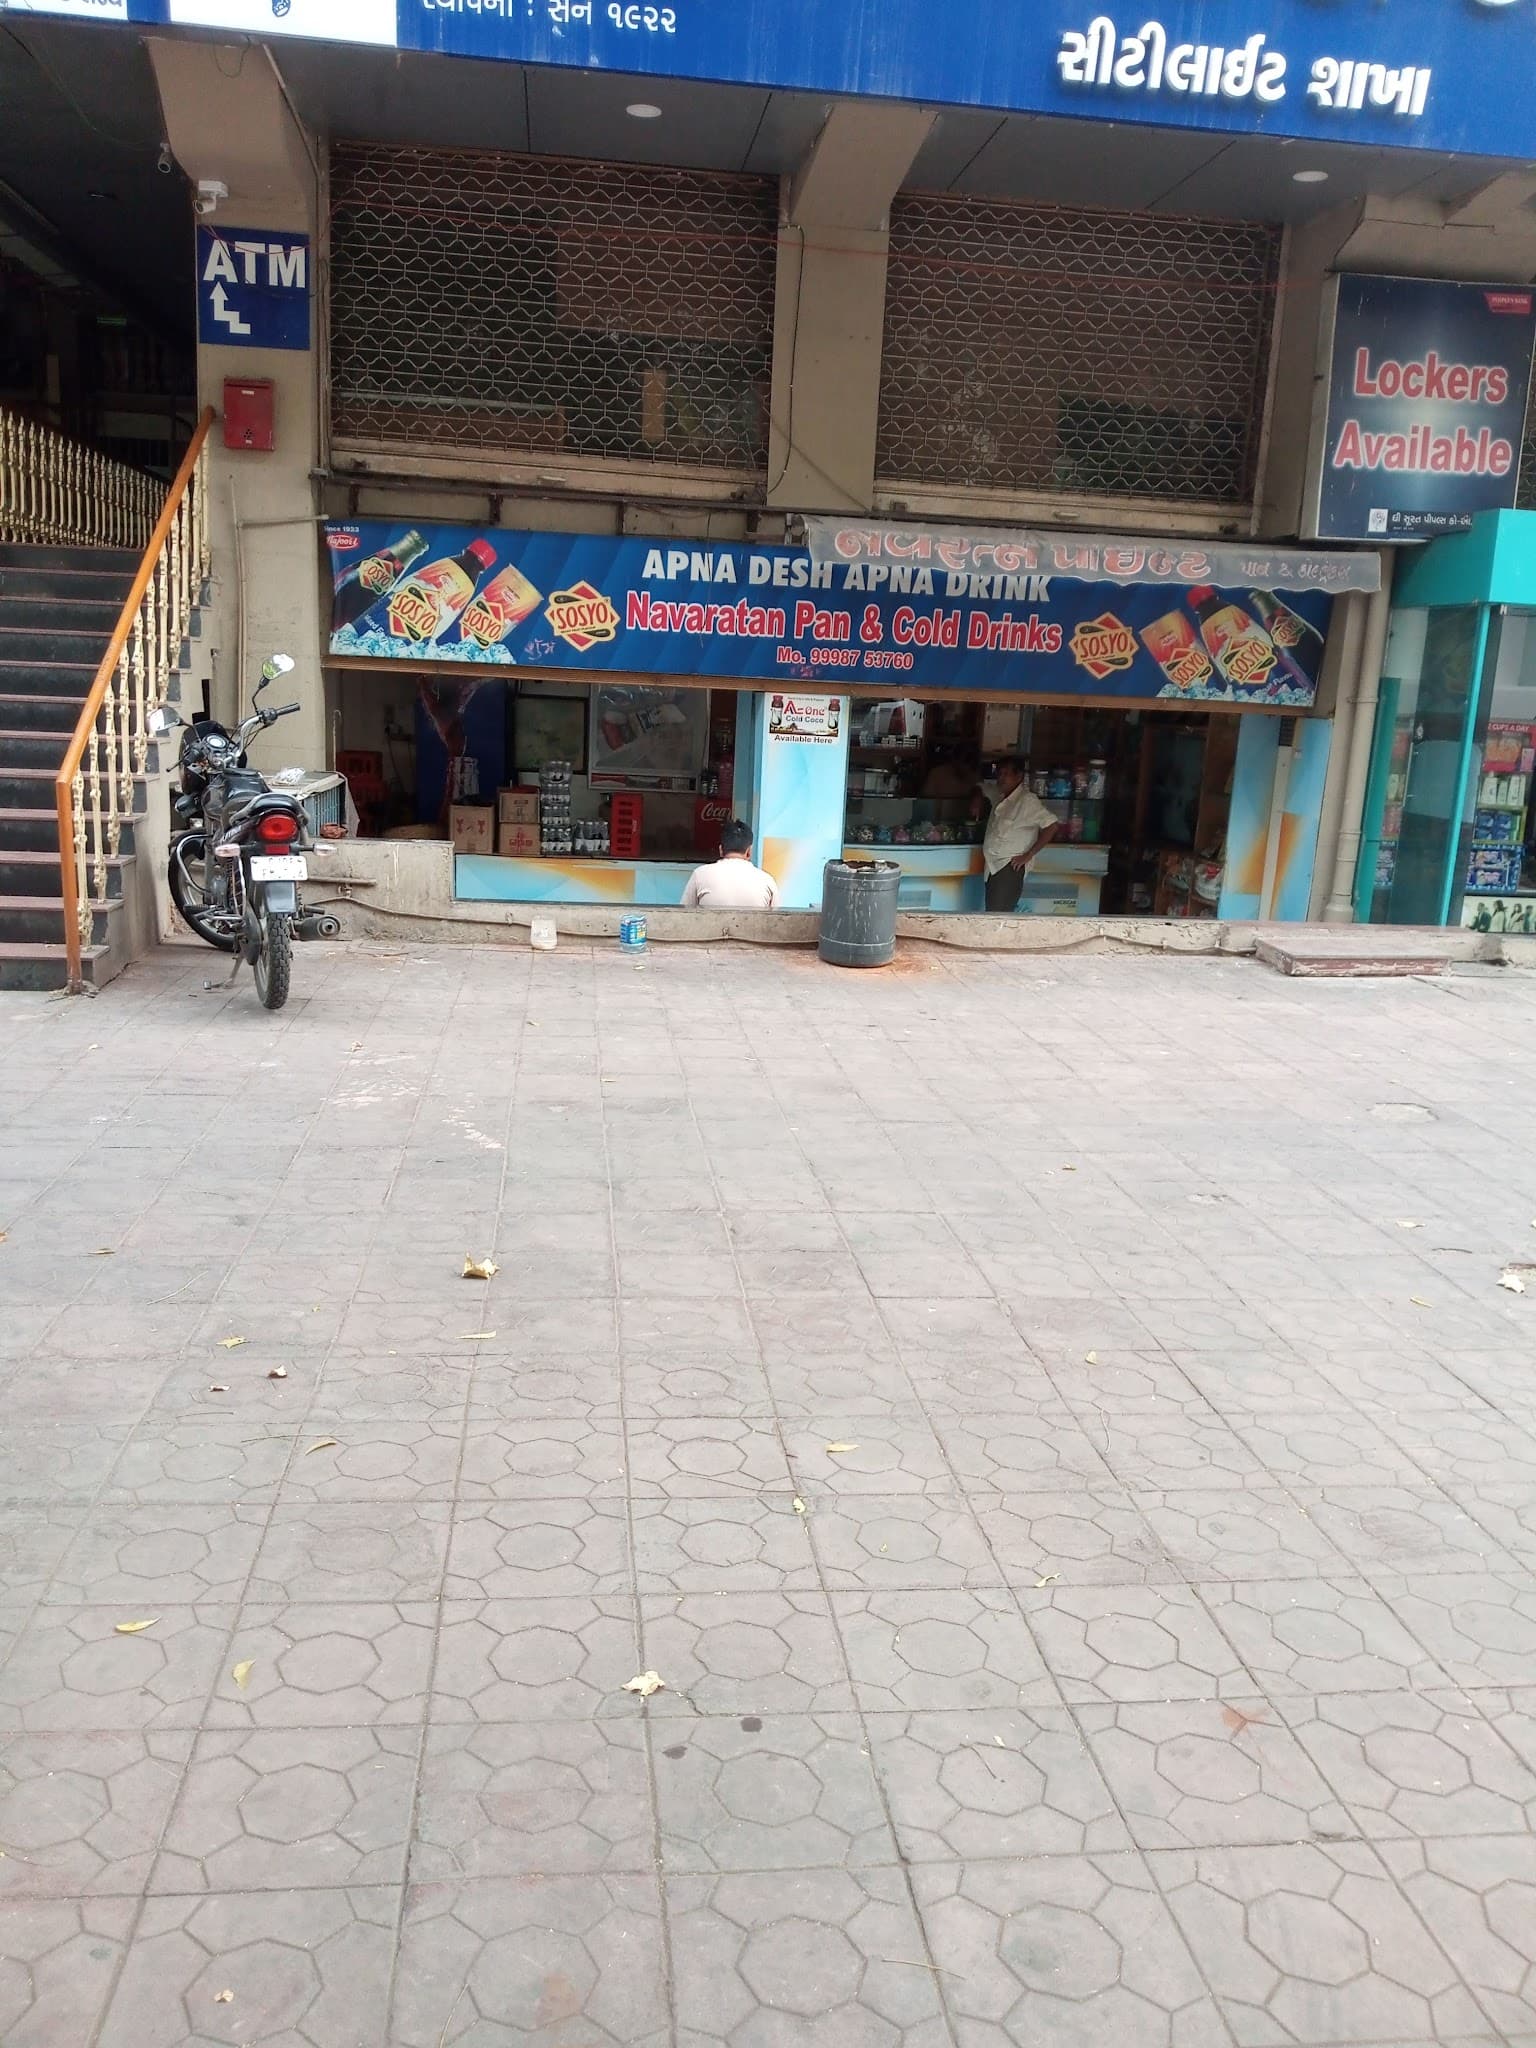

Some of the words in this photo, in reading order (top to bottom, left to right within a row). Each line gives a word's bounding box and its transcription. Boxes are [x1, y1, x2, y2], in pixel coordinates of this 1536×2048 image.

[607, 3, 676, 33] ૧૯૨૨
[1057, 16, 1287, 101] સીટીલાઈટ
[1307, 57, 1432, 115] શાખા
[203, 239, 306, 288] ATM
[1355, 347, 1508, 404] Lockers
[1333, 419, 1513, 476] Available
[642, 549, 737, 584] APNA
[748, 555, 833, 589] DESH
[843, 563, 935, 595] APNA
[946, 574, 1051, 602] DRINK
[393, 594, 437, 631] SOSYO
[463, 607, 502, 638] SOSYO
[556, 602, 609, 630] SOSYO
[626, 590, 786, 639] Navaratan
[793, 600, 851, 641] Pan
[859, 604, 884, 643] &
[892, 606, 962, 649] Cold
[967, 610, 1064, 653] Drinks
[776, 646, 806, 664] Mo.
[810, 647, 861, 667] 99987
[863, 650, 914, 670] 53760
[1079, 631, 1129, 659] SOSYO
[1229, 641, 1267, 680] SOSYO
[774, 735, 812, 743] Available
